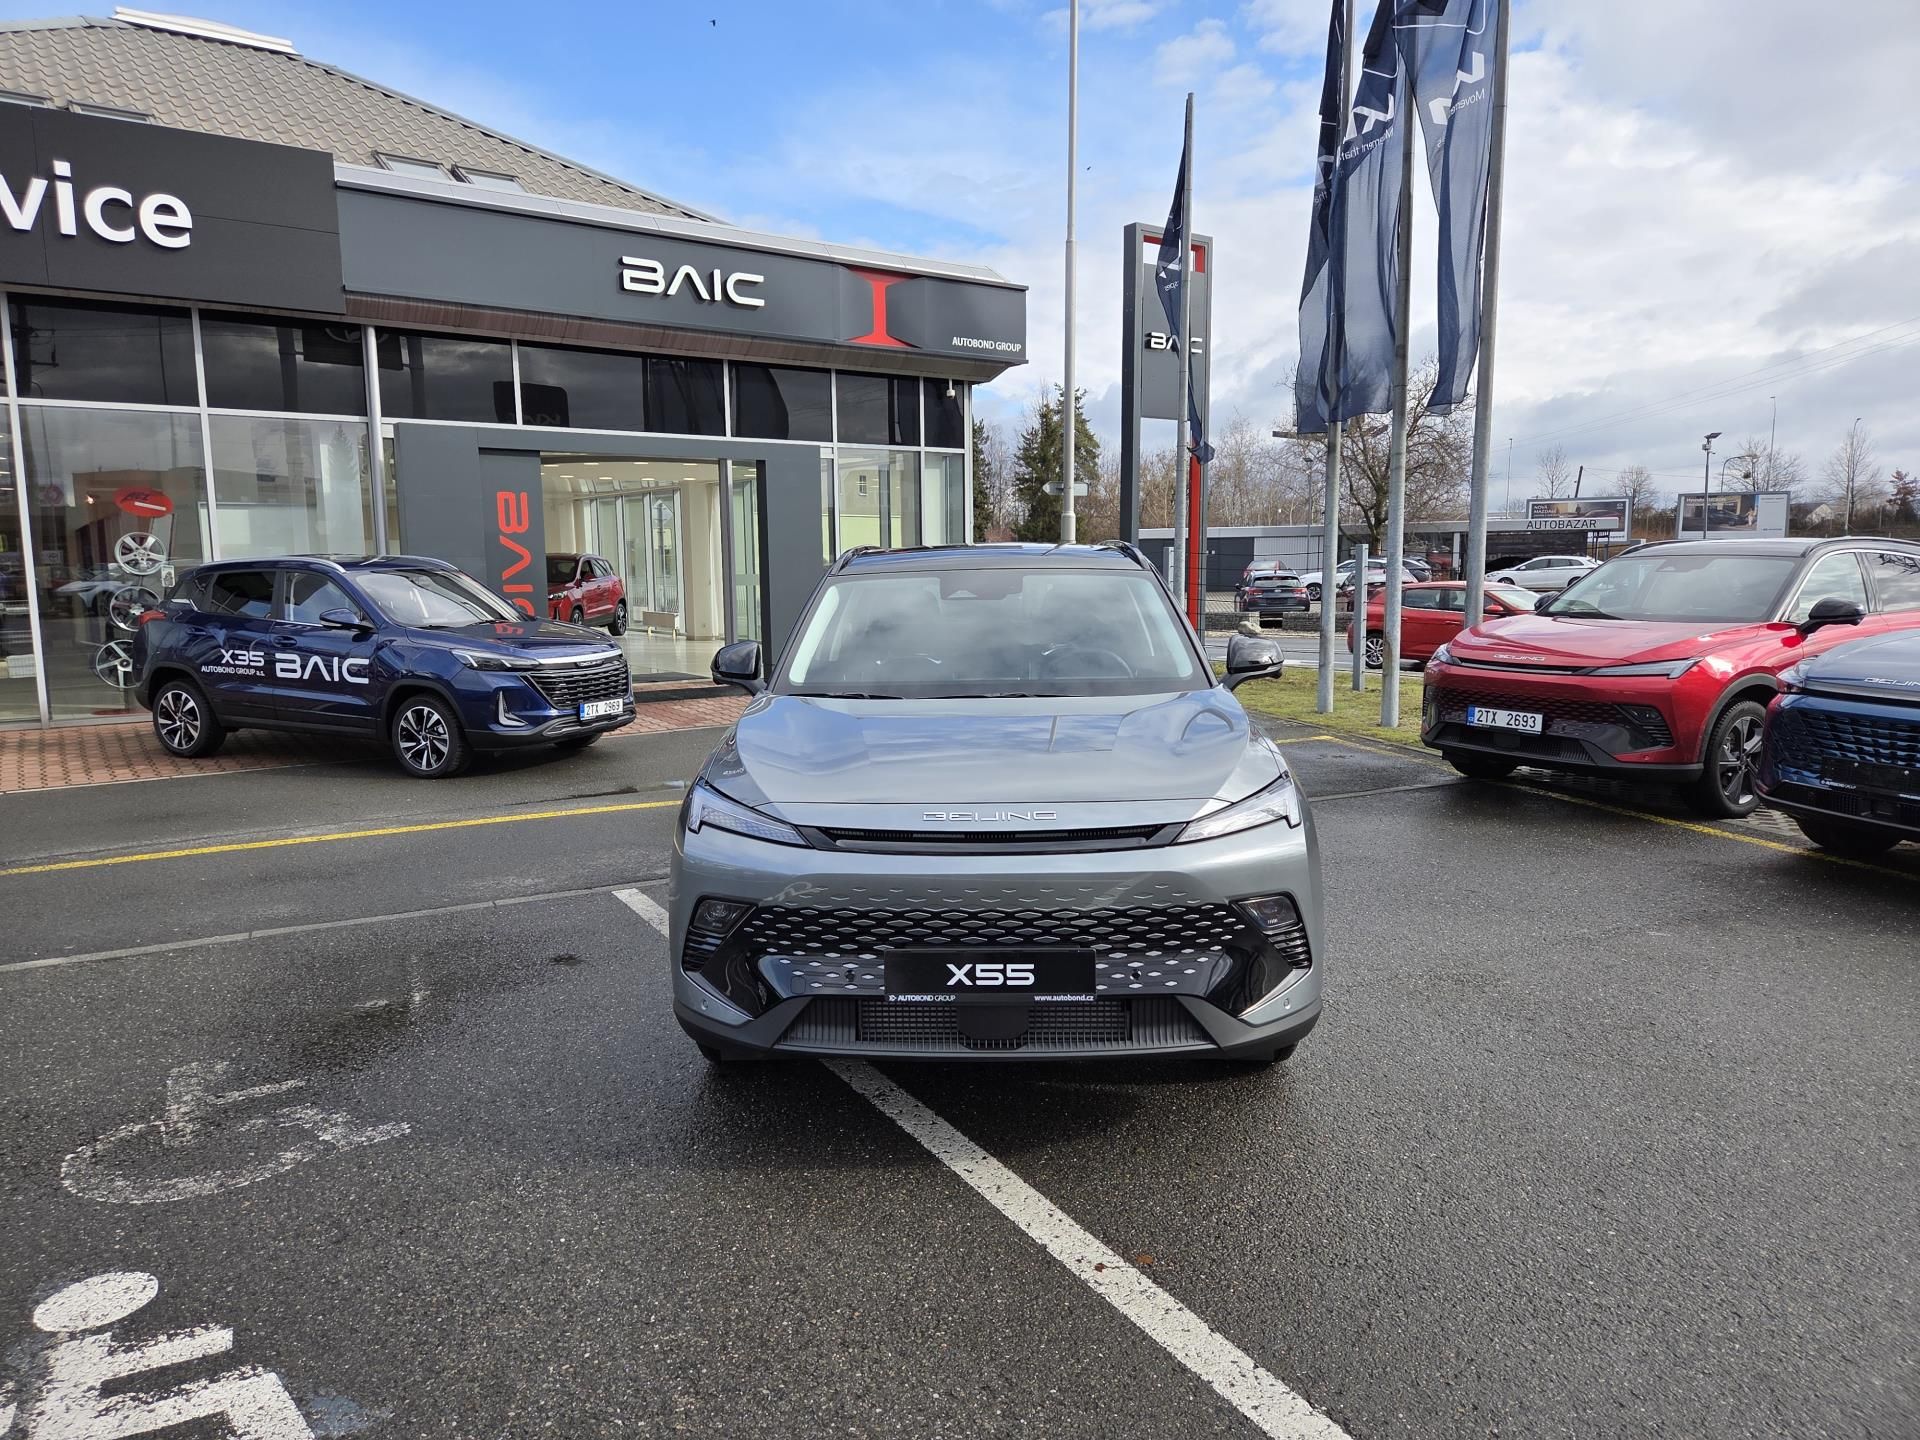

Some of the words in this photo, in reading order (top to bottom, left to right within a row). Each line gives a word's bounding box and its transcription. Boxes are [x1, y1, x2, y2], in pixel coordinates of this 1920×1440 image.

[622, 255, 765, 307] BAIC
[952, 336, 995, 350] AUTOBOND
[996, 341, 1022, 353] GROUP
[1526, 519, 1597, 530] AUTOBAZAR
[220, 649, 265, 667] X35
[201, 665, 236, 675] AUTOBOND
[236, 667, 256, 677] GROUP
[275, 652, 370, 685] BAIC
[586, 704, 599, 716] 2TX
[1477, 709, 1498, 725] 2TX
[1506, 713, 1537, 729] 2693
[923, 811, 1057, 821] BEIJING
[946, 963, 1035, 986] X55
